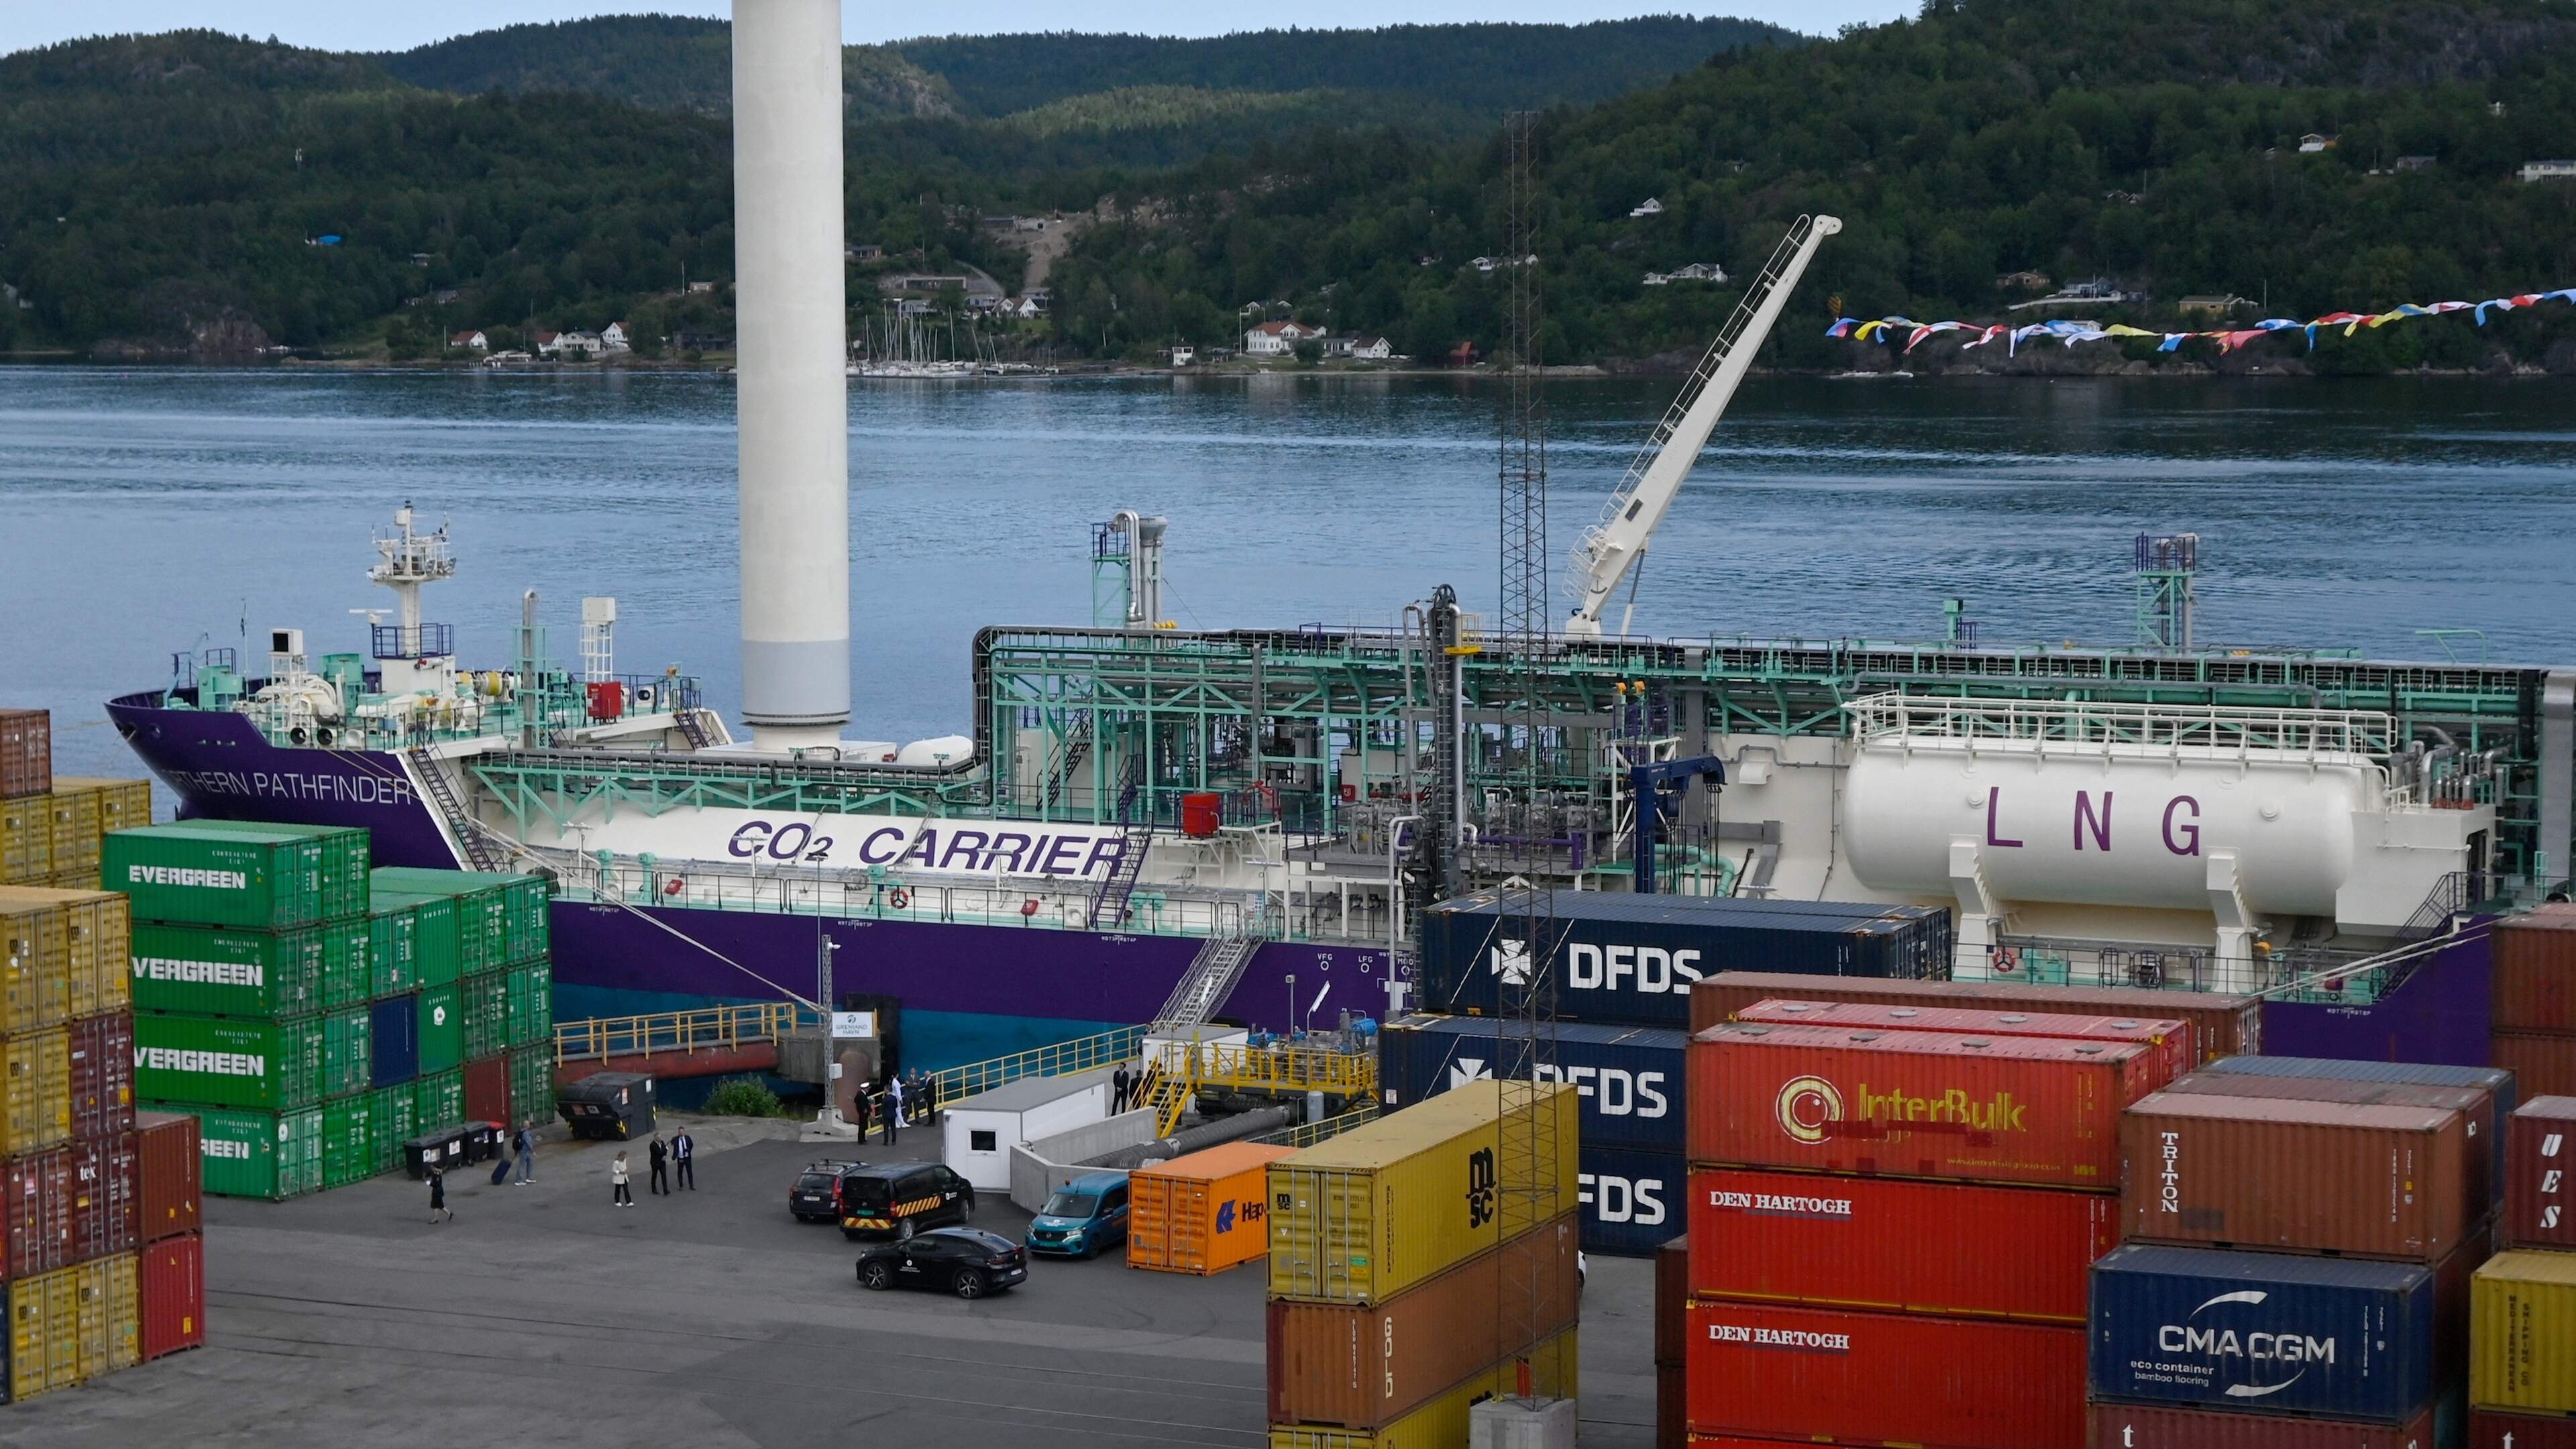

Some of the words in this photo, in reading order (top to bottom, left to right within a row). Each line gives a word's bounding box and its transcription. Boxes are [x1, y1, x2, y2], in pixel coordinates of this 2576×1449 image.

[254, 772, 411, 805] PATHFINDER
[1987, 786, 2201, 857] LNG
[859, 827, 1128, 876] CARRIER
[129, 865, 246, 890] EVERGREEN
[131, 957, 264, 987] VERGREEN
[1317, 953, 1333, 961] VFG
[1358, 955, 1374, 963] LFG
[1570, 943, 1703, 995] DFDS
[134, 1046, 264, 1077] VERGREEN
[1859, 1083, 2027, 1132] InterBulk
[201, 1138, 250, 1159] REEN
[80, 1167, 96, 1181] tex
[2161, 1132, 2179, 1213] TRITON
[2540, 1134, 2563, 1229] UES
[1242, 1201, 1267, 1222] Hap
[1578, 1173, 1666, 1225] FDS
[1710, 1191, 1752, 1208] DEN
[1754, 1194, 1851, 1214] HARTOGH
[1709, 1325, 1752, 1342] DEN
[1753, 1328, 1849, 1349] HARTOGH
[2159, 1325, 2244, 1358] CMA
[2248, 1332, 2335, 1364] CGM
[2508, 1295, 2517, 1393] MEDITERRANEAN
[2522, 1303, 2530, 1364] SHIPPING
[1384, 1316, 1393, 1399] GOLD
[2131, 1360, 2152, 1370] eco
[2155, 1362, 2214, 1375] container
[2135, 1371, 2173, 1383] bamboo
[2174, 1374, 2210, 1388] flooring
